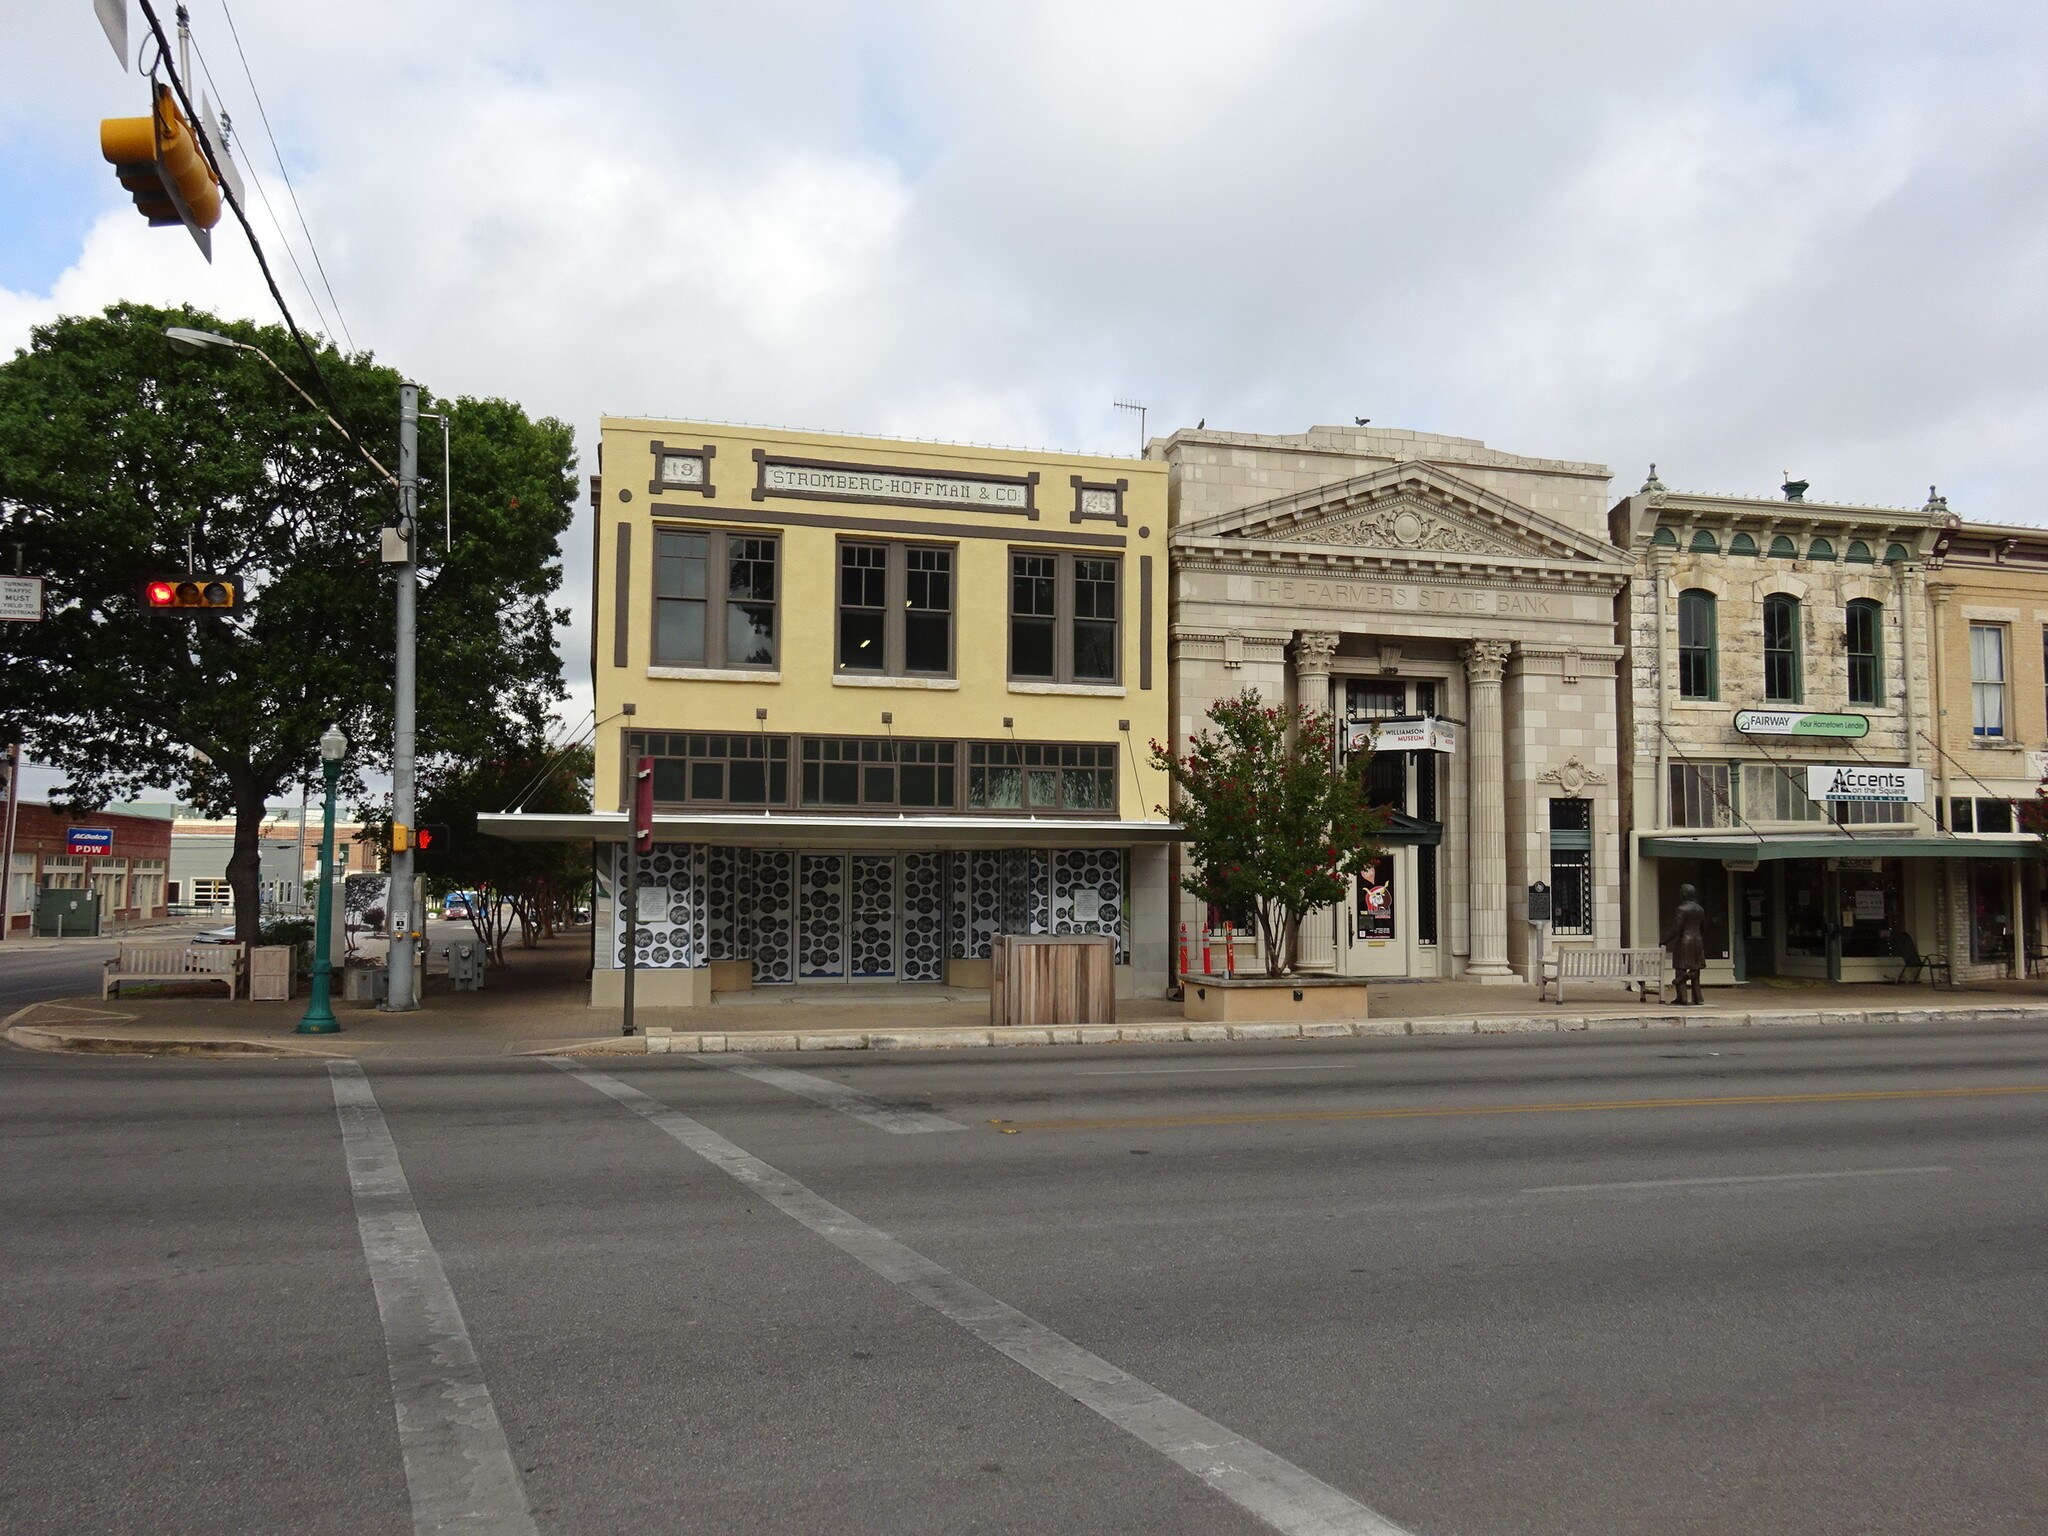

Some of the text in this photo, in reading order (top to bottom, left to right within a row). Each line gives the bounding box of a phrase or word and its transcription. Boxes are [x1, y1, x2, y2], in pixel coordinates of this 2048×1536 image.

[673, 463, 693, 476] 19
[773, 470, 970, 498] STROMBERG-HOFFMAN
[979, 486, 989, 500] &
[1253, 580, 1550, 614] THE FARMERS STATE BANK
[1750, 715, 1865, 730] FAIRWAY Your Hometown Lender
[1385, 728, 1425, 736] WILLIAMSON
[1827, 768, 1906, 793] Accents
[1864, 786, 1877, 794] the
[1878, 787, 1906, 797] Square
[75, 845, 103, 854] PDW
